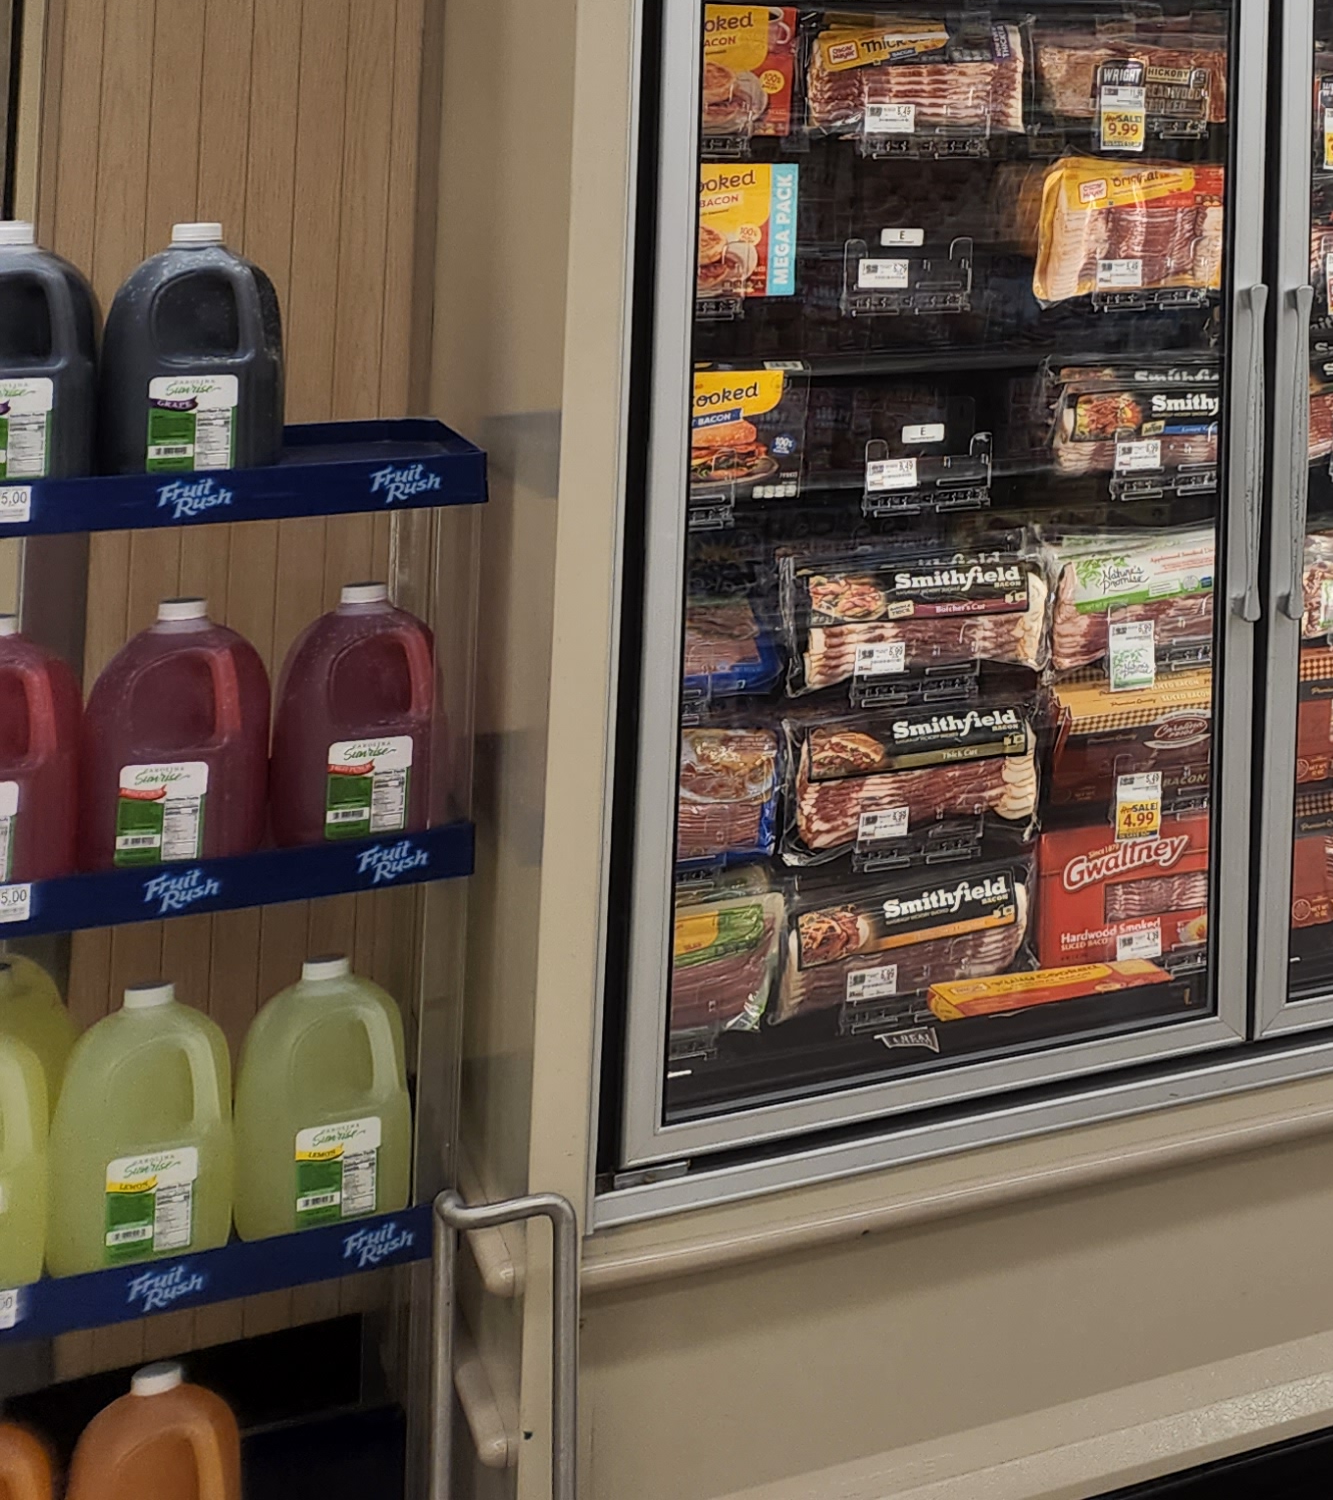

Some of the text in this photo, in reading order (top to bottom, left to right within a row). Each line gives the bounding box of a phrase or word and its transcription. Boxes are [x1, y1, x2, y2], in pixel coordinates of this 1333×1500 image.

[1103, 67, 1142, 84] WRIGHT
[1147, 68, 1189, 78] HICKORY
[1108, 121, 1138, 137] 9.99
[772, 174, 793, 285] MEGA PACK
[166, 383, 221, 396] Sunrise
[157, 478, 213, 508] Fruit
[370, 463, 424, 493] Fruit
[384, 472, 442, 504] Rush
[172, 489, 232, 519] Rush
[895, 566, 1021, 591] Smithfield
[892, 710, 1017, 739] Smithfield
[1122, 812, 1154, 828] 4.99
[357, 840, 408, 873] Fruit
[373, 849, 430, 884] Rush
[1063, 836, 1189, 891] Gwaltney
[144, 869, 201, 902] Fruit
[159, 877, 220, 913] Rush
[883, 877, 1009, 919] Smithfield
[981, 893, 1008, 905] BACON
[1061, 918, 1161, 945] Hardwood Smoked
[343, 1222, 395, 1258] Fruit
[357, 1228, 414, 1268] Rush
[128, 1266, 183, 1303] Fruit
[143, 1272, 204, 1312] Rush
